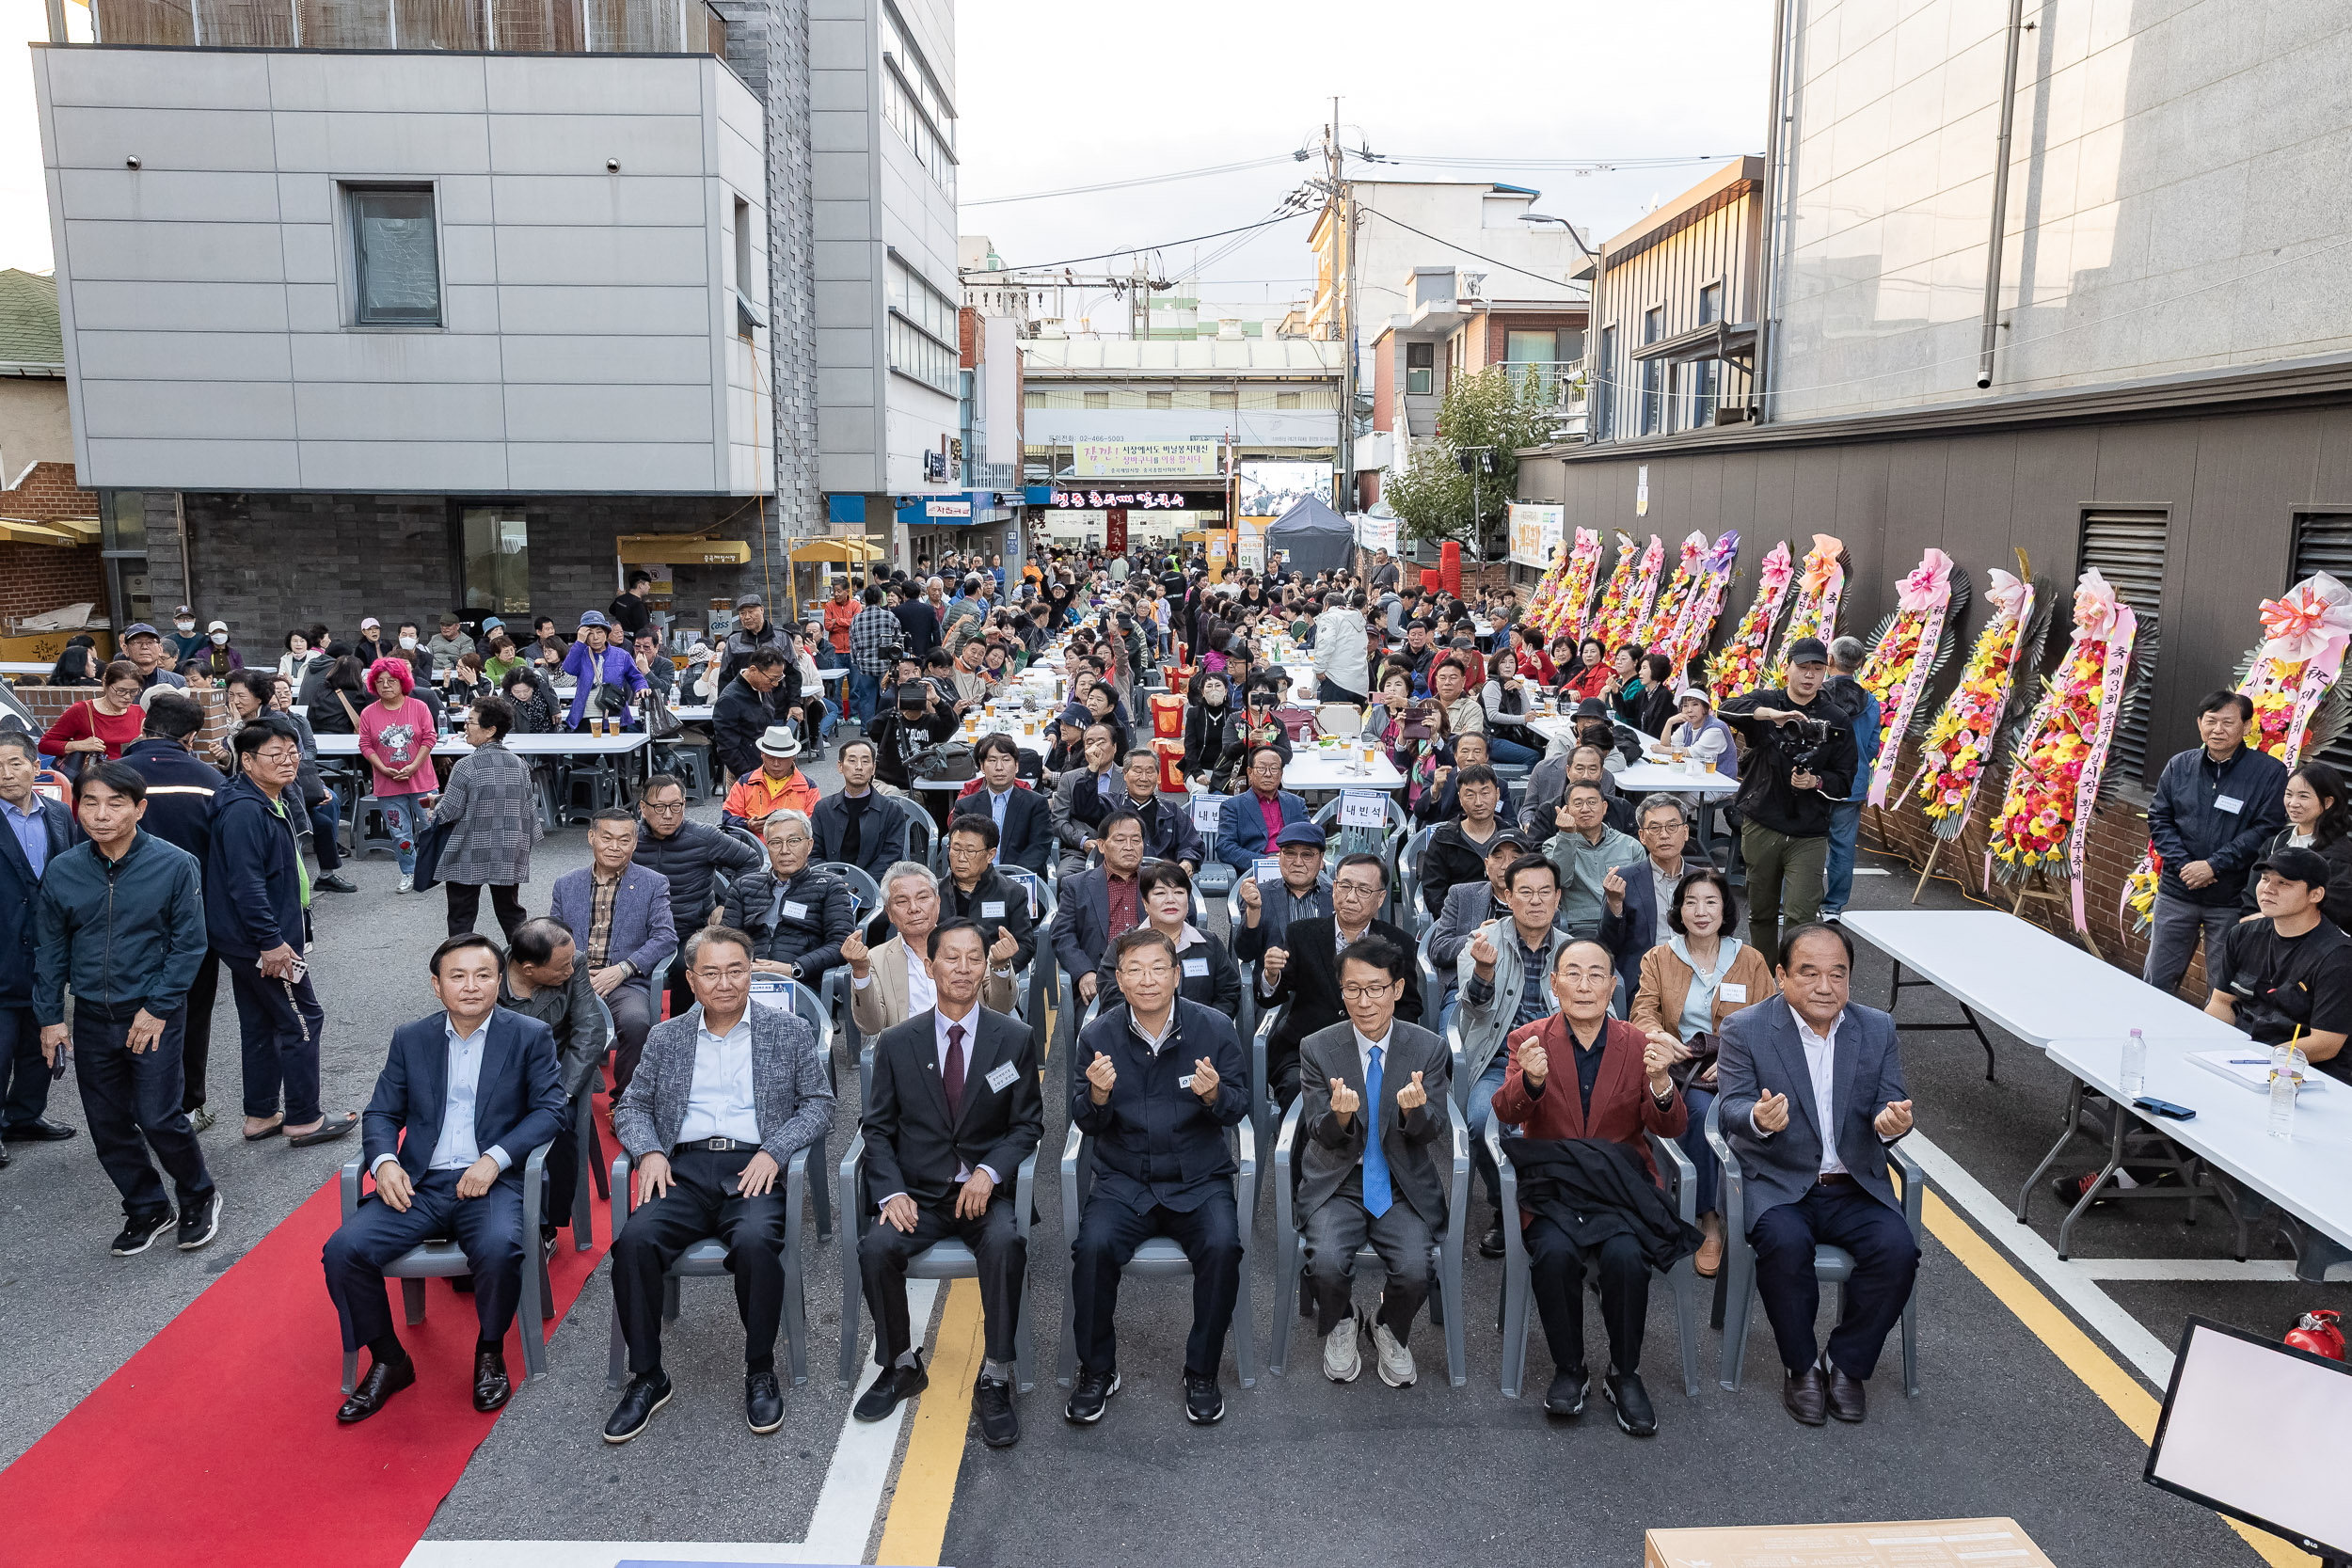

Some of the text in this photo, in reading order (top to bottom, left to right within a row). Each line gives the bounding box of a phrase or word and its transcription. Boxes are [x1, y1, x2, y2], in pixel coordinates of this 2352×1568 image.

[1084, 446, 1119, 461] 잠깐!
[1122, 445, 1208, 455] 시장에서도 비닐봉지대신
[1122, 455, 1159, 465] 장바구니를
[1161, 455, 1175, 465] 이용
[1136, 492, 1184, 509] 칼국수
[1826, 592, 1838, 606] 축
[2110, 646, 2128, 660] 축
[2105, 664, 2124, 705] 제3회
